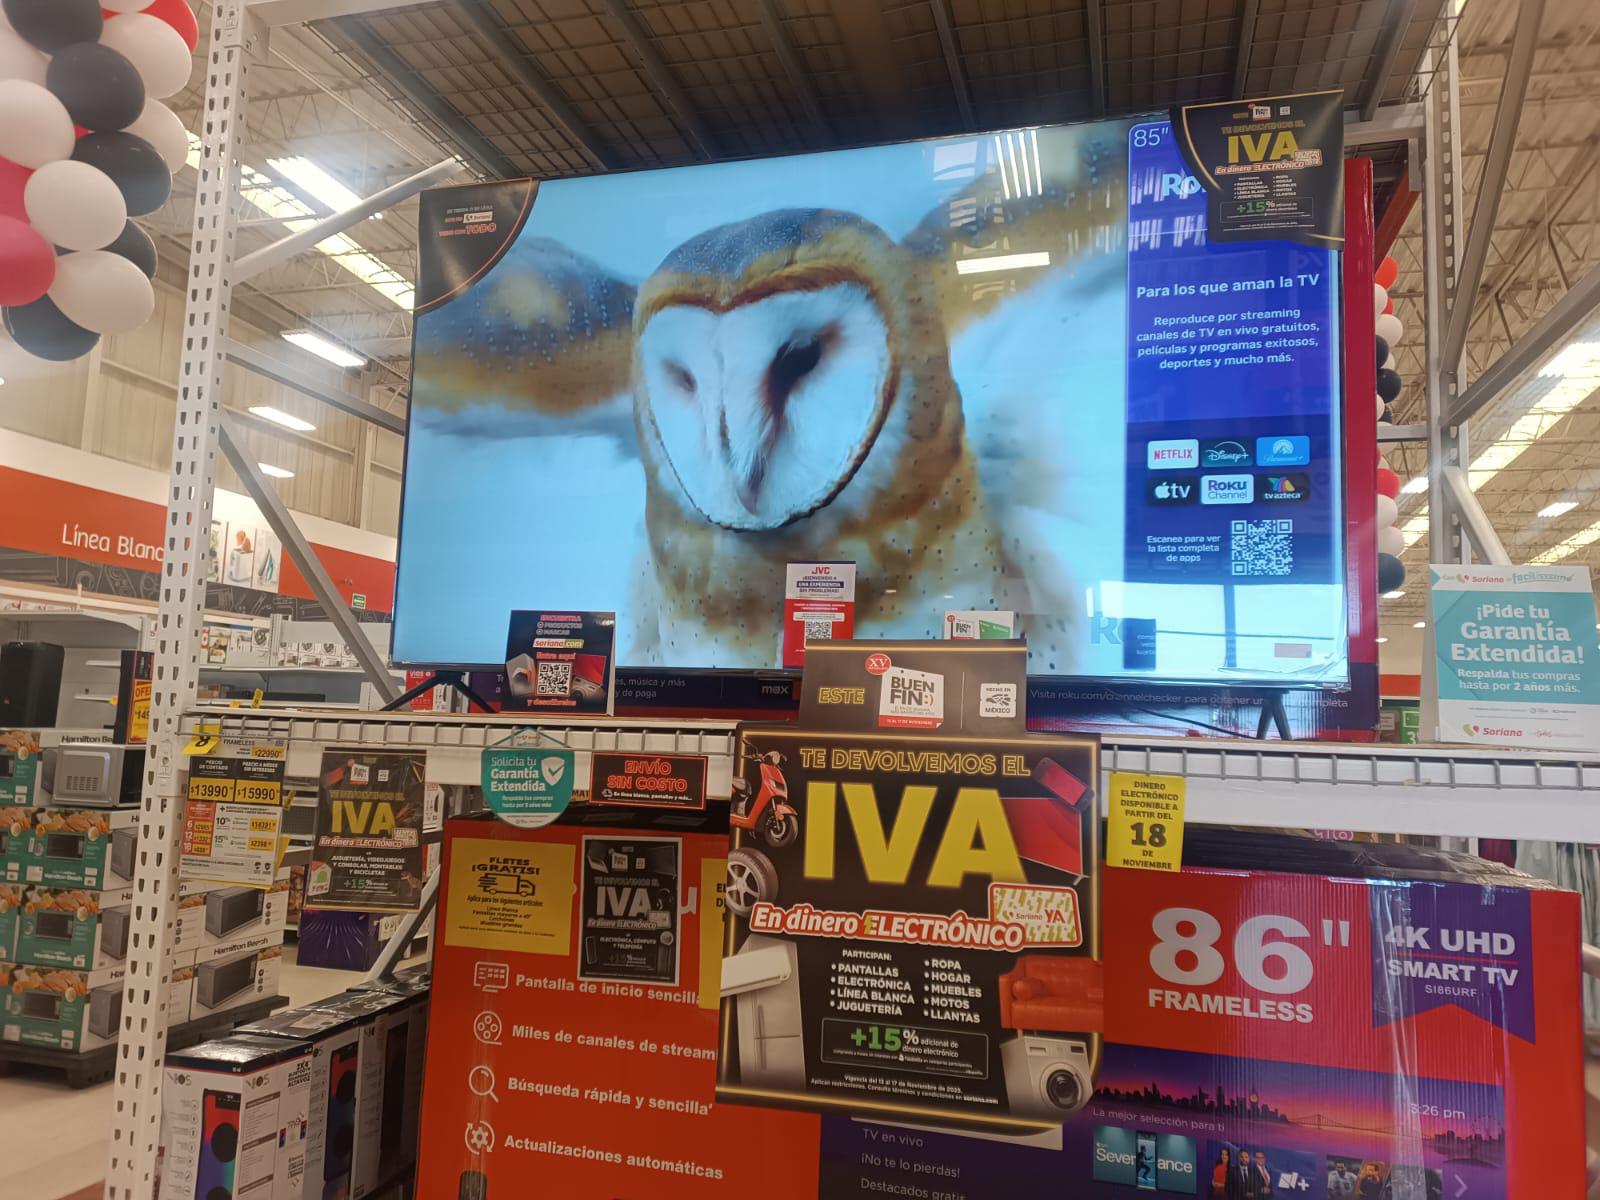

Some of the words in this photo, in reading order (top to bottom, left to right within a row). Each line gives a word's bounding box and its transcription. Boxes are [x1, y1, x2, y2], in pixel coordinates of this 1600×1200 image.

[1134, 128, 1169, 147] 85"
[1228, 130, 1299, 163] IVA
[1137, 286, 1169, 298] Para
[1174, 284, 1195, 295] los
[1200, 282, 1228, 295] que
[1233, 279, 1274, 291] aman
[1280, 277, 1293, 288] la
[1297, 274, 1319, 287] TV
[1154, 314, 1215, 327] Reproduce
[1218, 313, 1238, 324] por
[1240, 308, 1301, 320] streaming
[1136, 331, 1179, 342] canales
[1182, 329, 1195, 339] de
[1199, 328, 1215, 337] TV
[1218, 328, 1232, 336] en
[1235, 325, 1258, 335] vivo
[1262, 322, 1319, 336] gratuitos,
[1137, 344, 1187, 358] películas
[1190, 345, 1197, 355] y
[1200, 341, 1262, 354] programas
[1265, 338, 1318, 348] exitosos,
[1160, 358, 1212, 370] deportes
[1214, 358, 1221, 367] y
[1225, 354, 1263, 365] mucho
[1267, 352, 1294, 362] más.
[1154, 449, 1193, 460] NETFLIX
[1208, 480, 1248, 490] Roku
[1208, 491, 1248, 500] Channel
[61, 523, 110, 553] Línea
[117, 535, 164, 561] Blanc
[1185, 536, 1205, 545] para
[1178, 544, 1220, 554] completa
[1180, 554, 1200, 563] apps
[1477, 603, 1525, 621] ¡Pide
[1529, 604, 1550, 618] tu
[1461, 620, 1571, 641] Garantía
[1451, 643, 1584, 664] Extendida!
[869, 659, 887, 668] XV
[1457, 668, 1510, 679] Respalda
[1512, 671, 1530, 679] tus
[1532, 671, 1580, 681] compras
[629, 678, 658, 687] música
[668, 678, 686, 687] más
[762, 686, 788, 694] max
[891, 676, 934, 693] BUEN
[1460, 681, 1490, 690] hasta
[1492, 682, 1510, 691] por
[1514, 682, 1521, 690] 2
[1523, 681, 1550, 691] años
[1553, 683, 1580, 692] más.
[636, 690, 657, 699] paga
[818, 687, 865, 704] ESTE
[1031, 690, 1056, 699] Visita
[1185, 696, 1208, 705] para
[1483, 728, 1522, 737] Soriana
[491, 757, 524, 767] Solicita
[624, 758, 671, 776] ENVÍO
[800, 748, 826, 768] TE
[831, 750, 996, 774] DEVOLVEMOS
[1002, 756, 1030, 777] EL
[491, 768, 540, 780] Garantía
[491, 780, 546, 792] Extendida
[607, 775, 632, 789] SIN
[635, 777, 687, 792] COSTO
[1134, 781, 1166, 790] DINERO
[1120, 790, 1179, 800] ELECTRÓNICO
[1121, 800, 1170, 810] DISPONIBLE
[331, 800, 397, 834] IVA
[1125, 809, 1155, 818] PARTIR
[1157, 812, 1173, 820] DEL
[804, 781, 1028, 888] IVA
[1131, 822, 1167, 847] 18
[490, 857, 529, 865] FLETES
[1123, 859, 1172, 870] NOVIEMBRE
[596, 886, 651, 917] IVA
[1044, 909, 1065, 923] YA
[755, 905, 781, 930] En
[786, 905, 858, 934] dinero
[864, 910, 1024, 948] ELECTRÓNICO
[1385, 925, 1430, 949] 4K
[1440, 928, 1516, 956] UHD
[842, 950, 892, 960] PARTICIPAN:
[1149, 907, 1351, 995] 86"
[838, 963, 899, 977] PANTALLAS
[931, 959, 961, 970] ROPA
[931, 971, 971, 983] HOGAR
[1388, 960, 1476, 982] SMART
[1482, 967, 1519, 987] TV
[516, 974, 574, 992] Pantalla
[579, 982, 597, 994] de
[602, 983, 643, 998] inicio
[838, 976, 911, 991] ELECTRÓNICA
[931, 984, 982, 998] MUEBLES
[837, 988, 868, 1000] LÍNEA
[871, 991, 915, 1004] BLANCA
[931, 997, 970, 1009] MOTOS
[837, 1001, 903, 1016] JUGUETERÍA
[1148, 988, 1314, 1023] FRAMELESS
[930, 1010, 980, 1023] LLANTAS
[512, 1025, 550, 1041] Miles
[554, 1029, 572, 1043] de
[577, 1032, 635, 1051] canales
[639, 1039, 657, 1053] de
[662, 1042, 718, 1061] stream
[851, 1026, 919, 1051] +15%
[921, 1038, 949, 1048] adicional
[902, 1046, 922, 1054] dinero
[924, 1048, 959, 1058] electrónico
[508, 1077, 580, 1098] Búsqueda
[584, 1086, 631, 1105] rápida
[635, 1095, 645, 1109] y
[1108, 1111, 1137, 1121] mejor
[1140, 1115, 1188, 1128] selección
[1191, 1120, 1215, 1130] para
[1444, 1109, 1465, 1120] pm
[863, 1129, 878, 1139] TV
[882, 1133, 895, 1143] en
[899, 1134, 924, 1148] vivo
[504, 1135, 622, 1164] Actualizaciones
[626, 1153, 723, 1179] automáticas
[861, 1153, 881, 1166] ¡No
[885, 1156, 896, 1168] te
[899, 1157, 910, 1170] lo
[914, 1162, 960, 1177] pierdas!
[861, 1178, 928, 1199] Destacados
